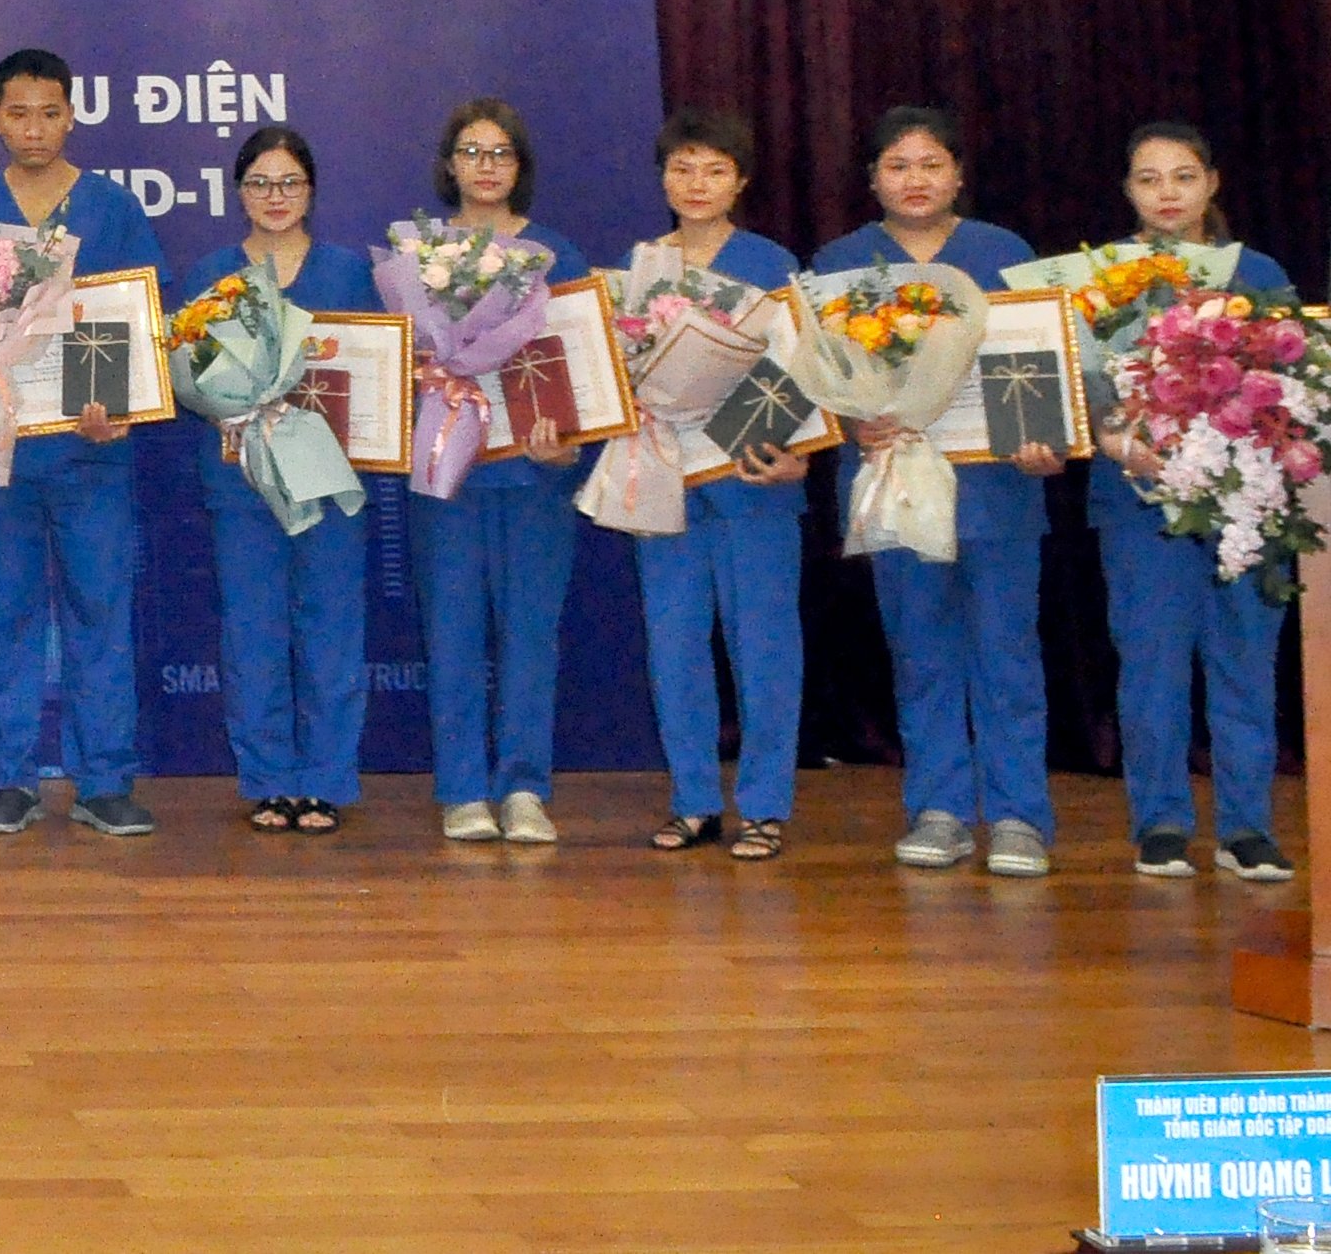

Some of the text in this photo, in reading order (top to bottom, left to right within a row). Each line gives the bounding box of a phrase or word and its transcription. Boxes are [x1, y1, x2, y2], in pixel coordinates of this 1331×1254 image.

[133, 59, 288, 138] ĐIỆN
[1136, 1095, 1182, 1116] THÀNH
[1184, 1093, 1218, 1115] VIÊN
[1220, 1093, 1245, 1117] HỘI
[1247, 1089, 1287, 1114] ĐỒNG
[1164, 1114, 1201, 1139] TỔNG
[1203, 1117, 1242, 1138] GIÁM
[1245, 1114, 1275, 1137] ĐỐC
[1121, 1153, 1212, 1201] HUỲNH
[1219, 1158, 1313, 1200] QUANG
